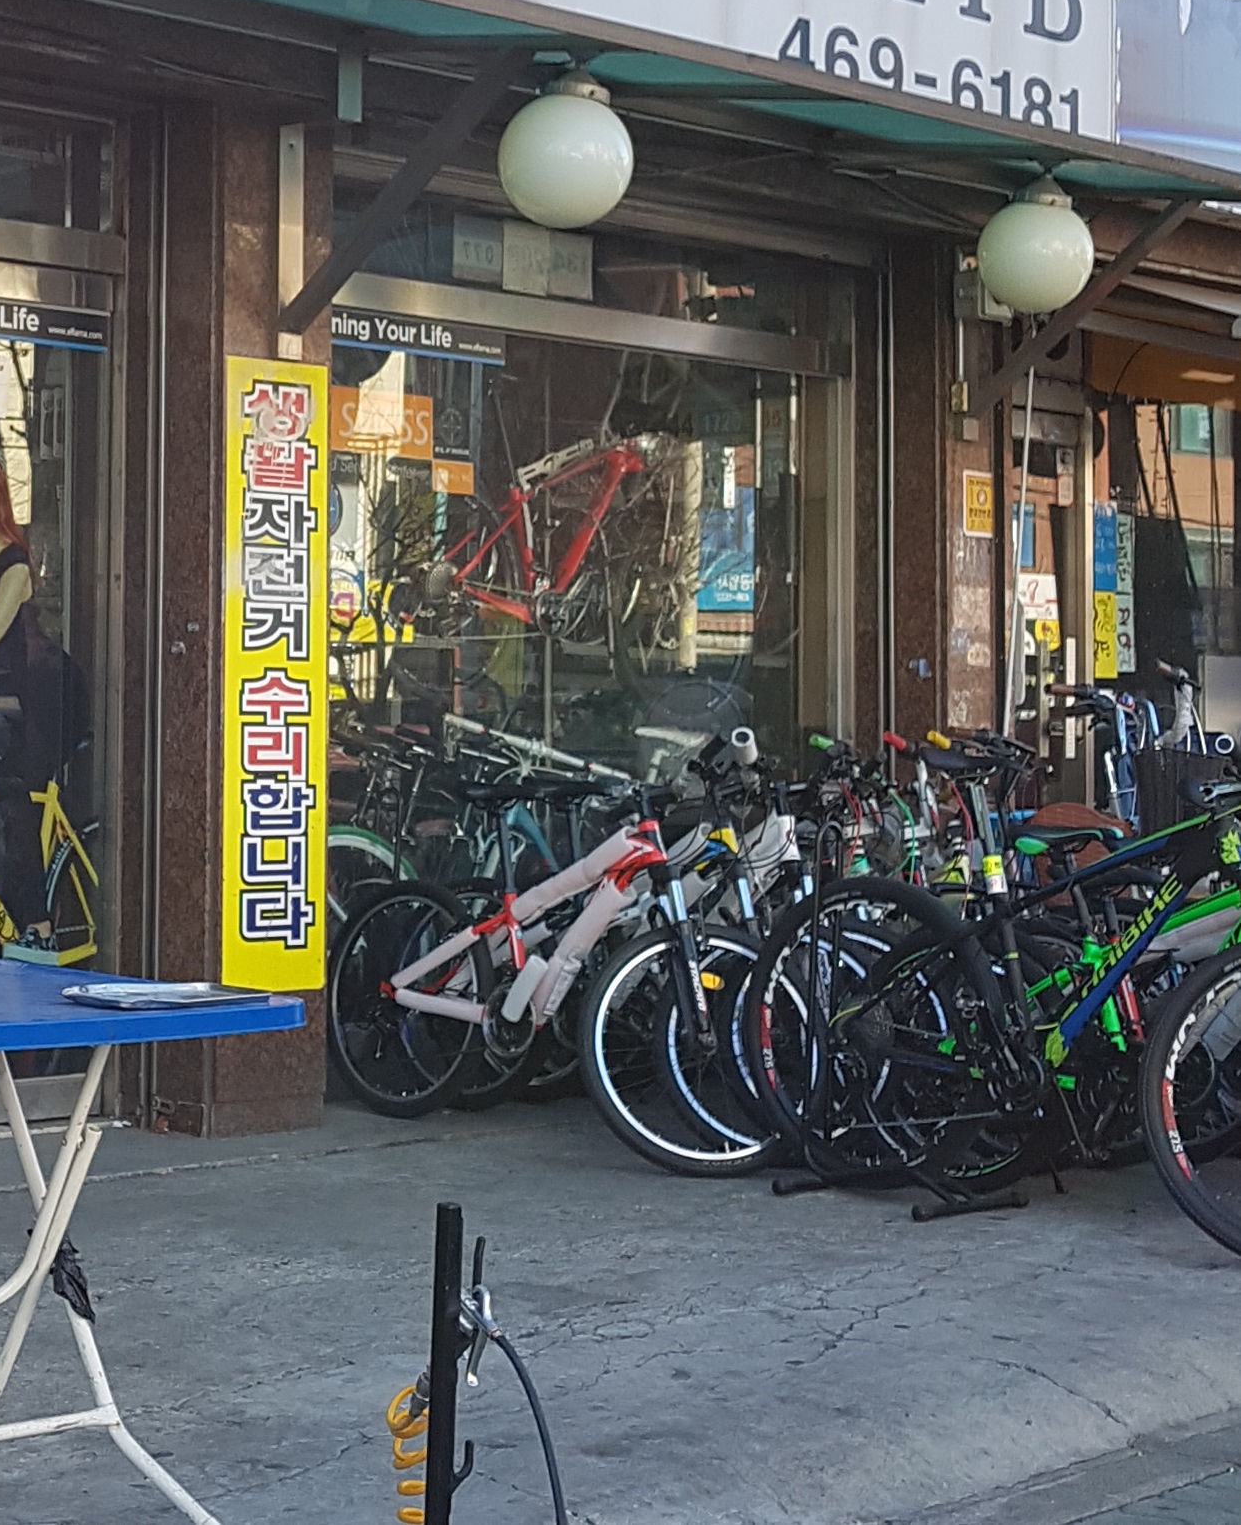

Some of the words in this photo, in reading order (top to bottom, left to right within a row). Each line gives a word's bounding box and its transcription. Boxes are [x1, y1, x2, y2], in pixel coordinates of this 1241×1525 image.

[779, 18, 1081, 137] 469-6181
[0, 305, 40, 332] Life
[331, 314, 370, 340] ning
[375, 318, 416, 342] Your
[421, 324, 452, 348] Life
[240, 669, 315, 950] 수리합니다
